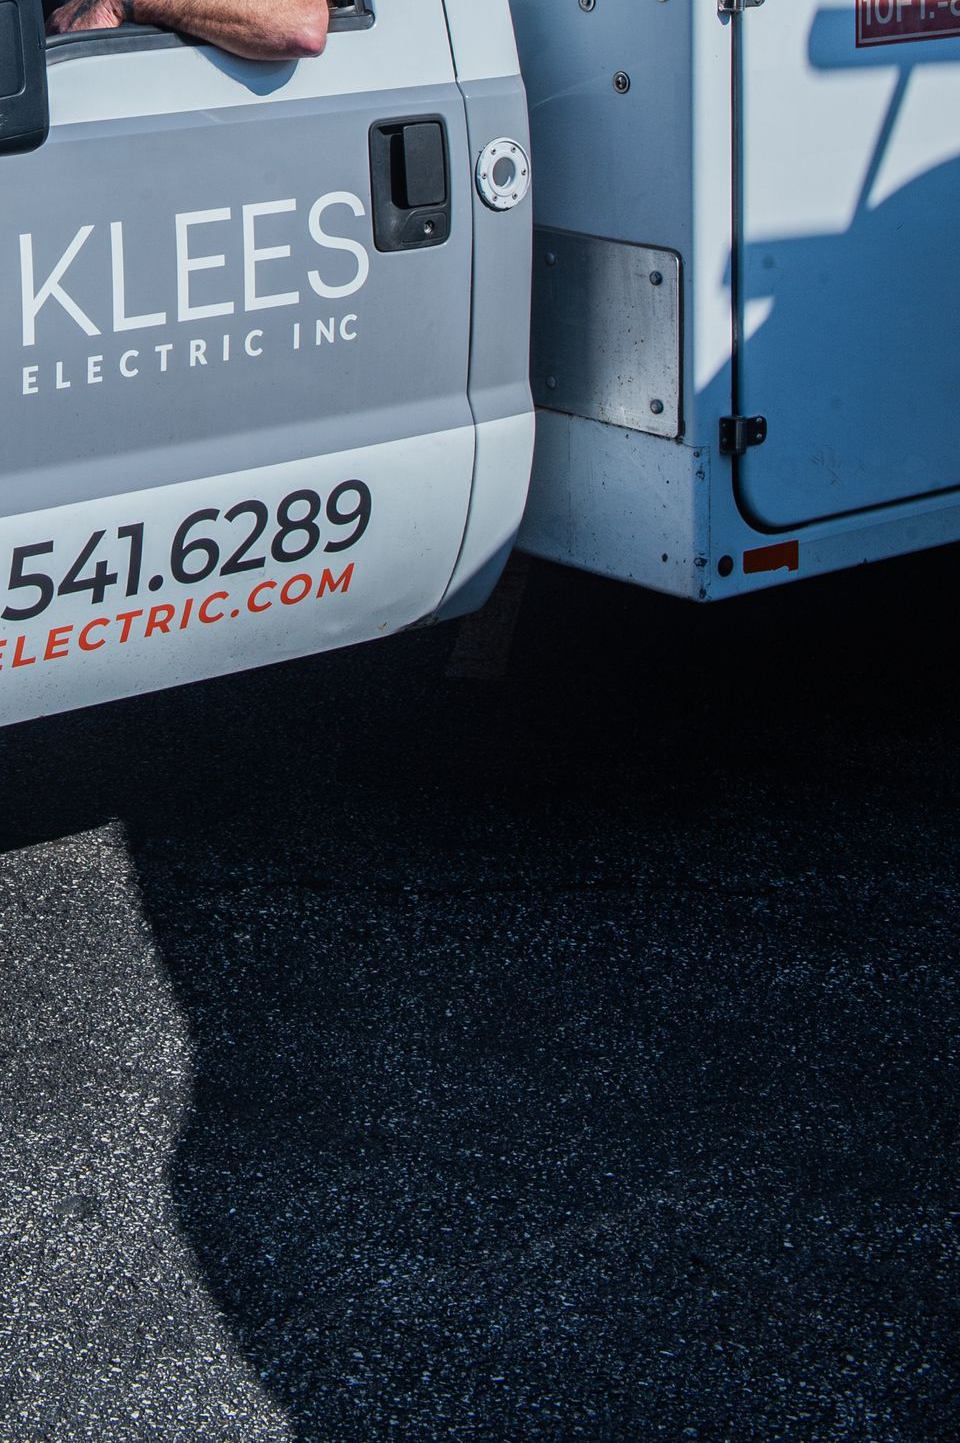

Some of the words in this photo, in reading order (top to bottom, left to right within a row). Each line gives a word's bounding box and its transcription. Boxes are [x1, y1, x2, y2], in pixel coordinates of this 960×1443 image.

[18, 190, 370, 347] KLEES
[22, 329, 264, 395] ELECTRIC
[293, 313, 359, 350] INC
